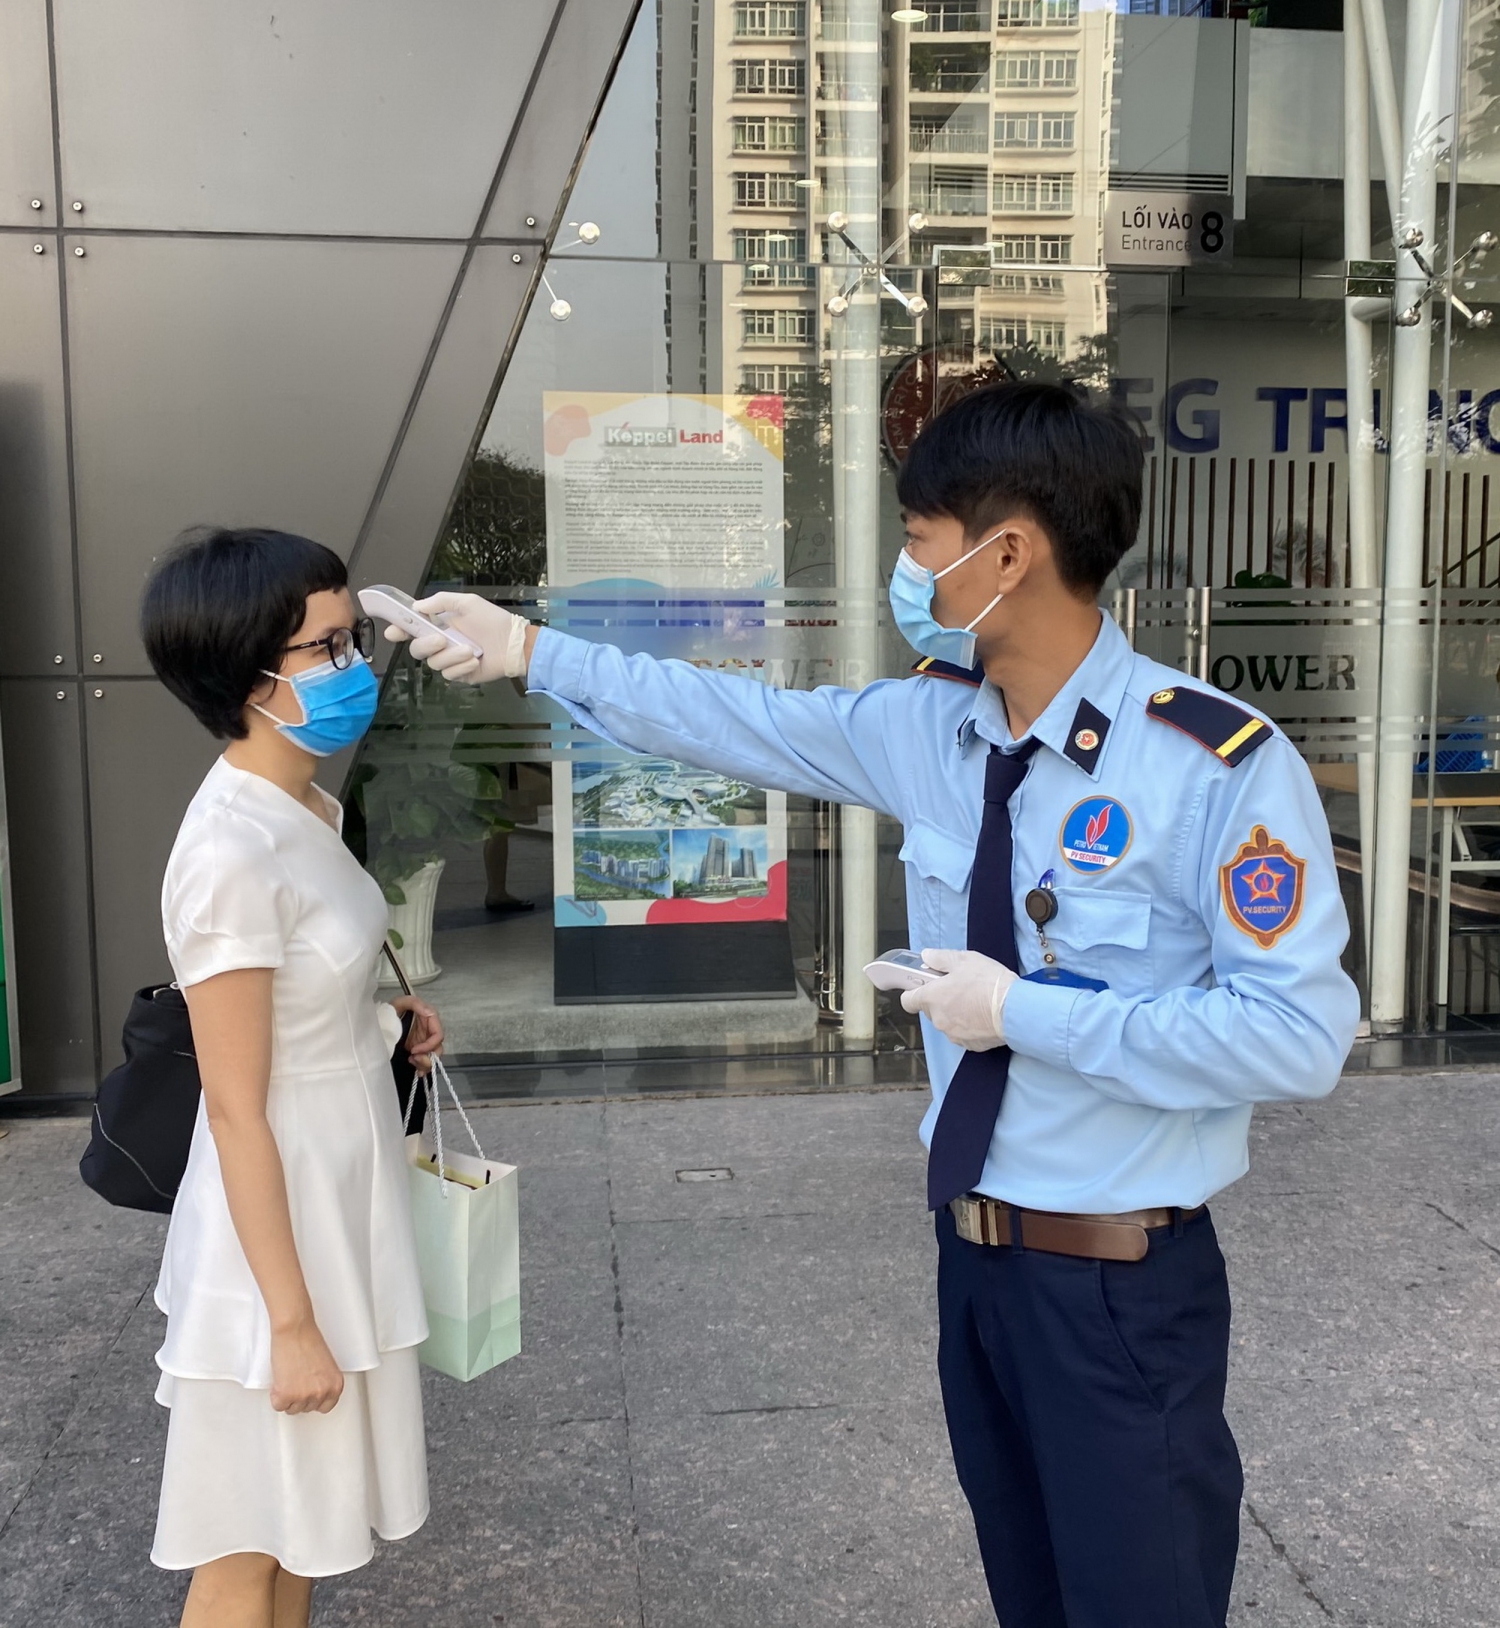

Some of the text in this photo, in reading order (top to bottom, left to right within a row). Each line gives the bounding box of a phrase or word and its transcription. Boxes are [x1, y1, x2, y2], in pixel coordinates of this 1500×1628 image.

[1121, 204, 1193, 230] LỐI VÀO
[1200, 210, 1224, 253] 8
[1121, 234, 1192, 252] Entrance
[679, 429, 724, 444] Land
[1070, 851, 1106, 863] PV SECURITY
